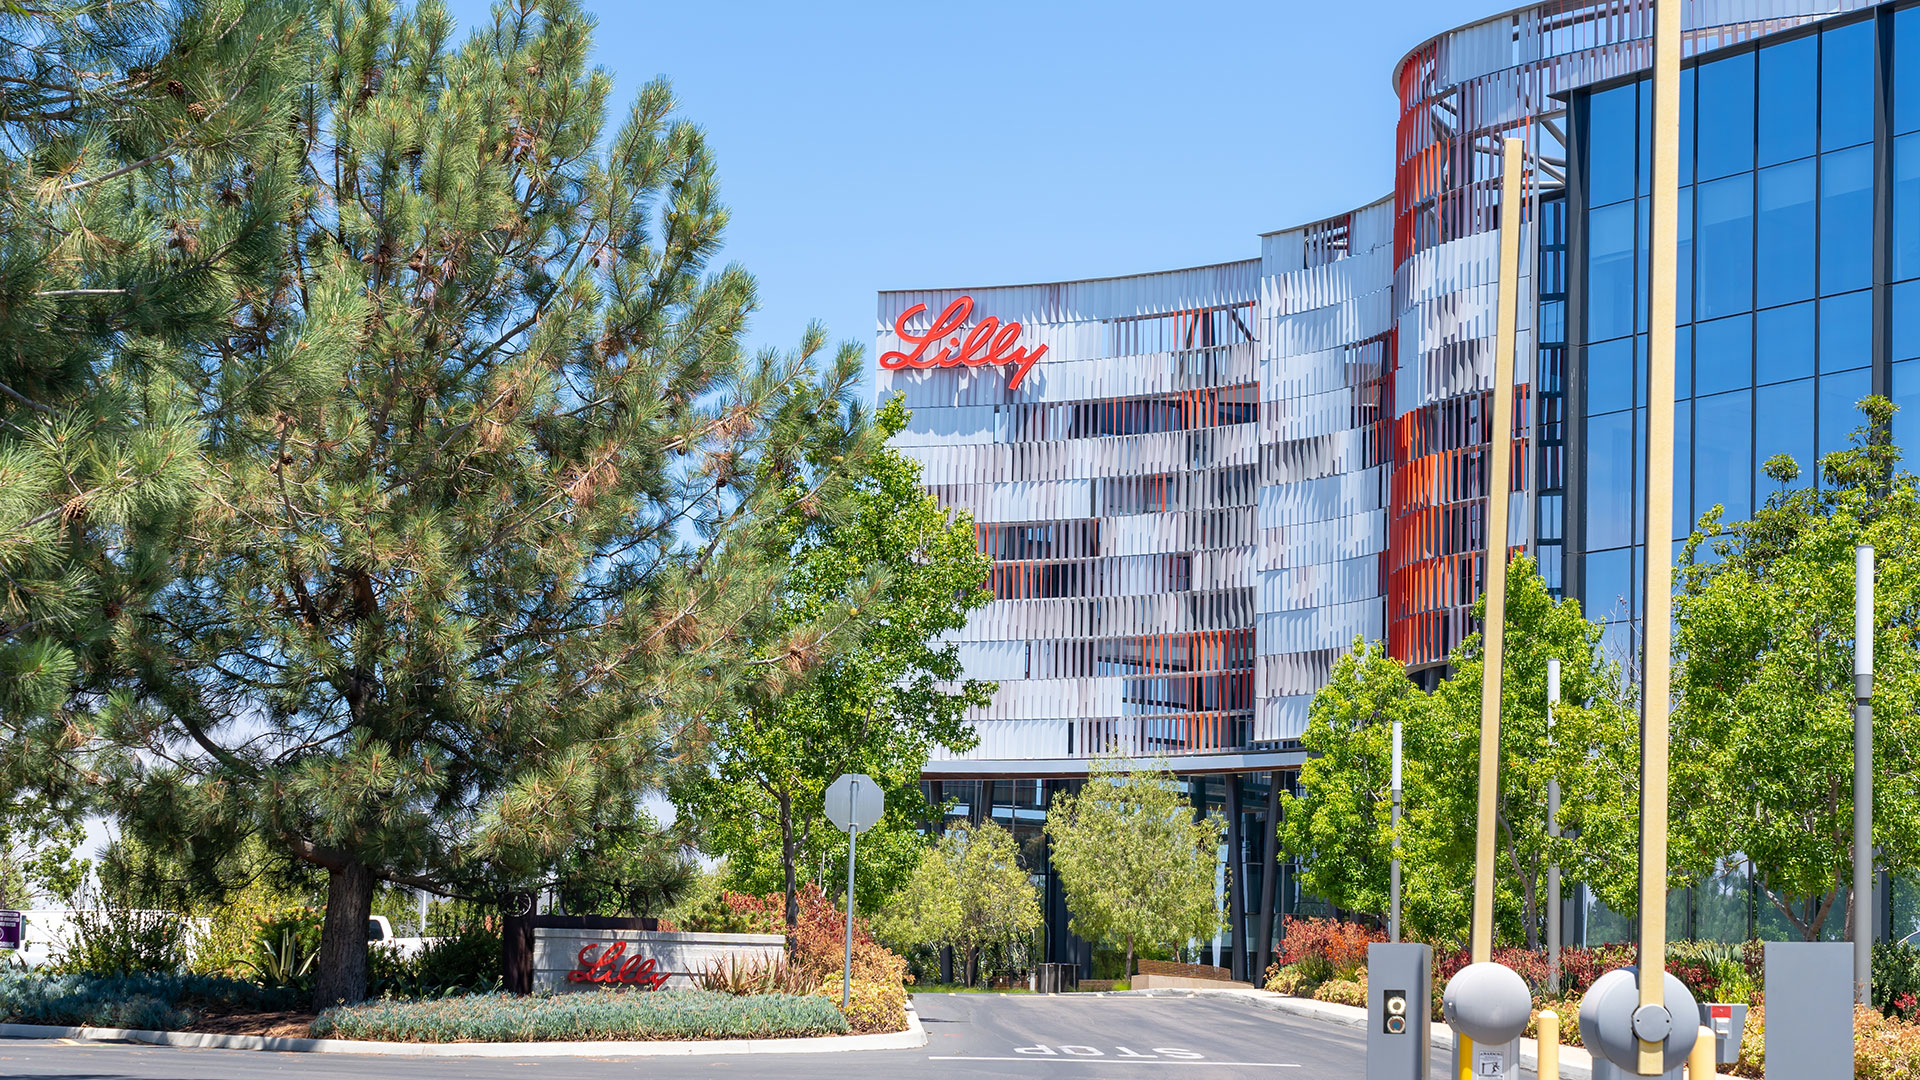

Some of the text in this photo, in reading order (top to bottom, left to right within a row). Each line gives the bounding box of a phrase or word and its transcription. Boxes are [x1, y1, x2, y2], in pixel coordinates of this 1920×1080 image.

[880, 296, 1049, 390] Lilly
[569, 940, 672, 991] Lilly
[1013, 1044, 1205, 1059] STOP
